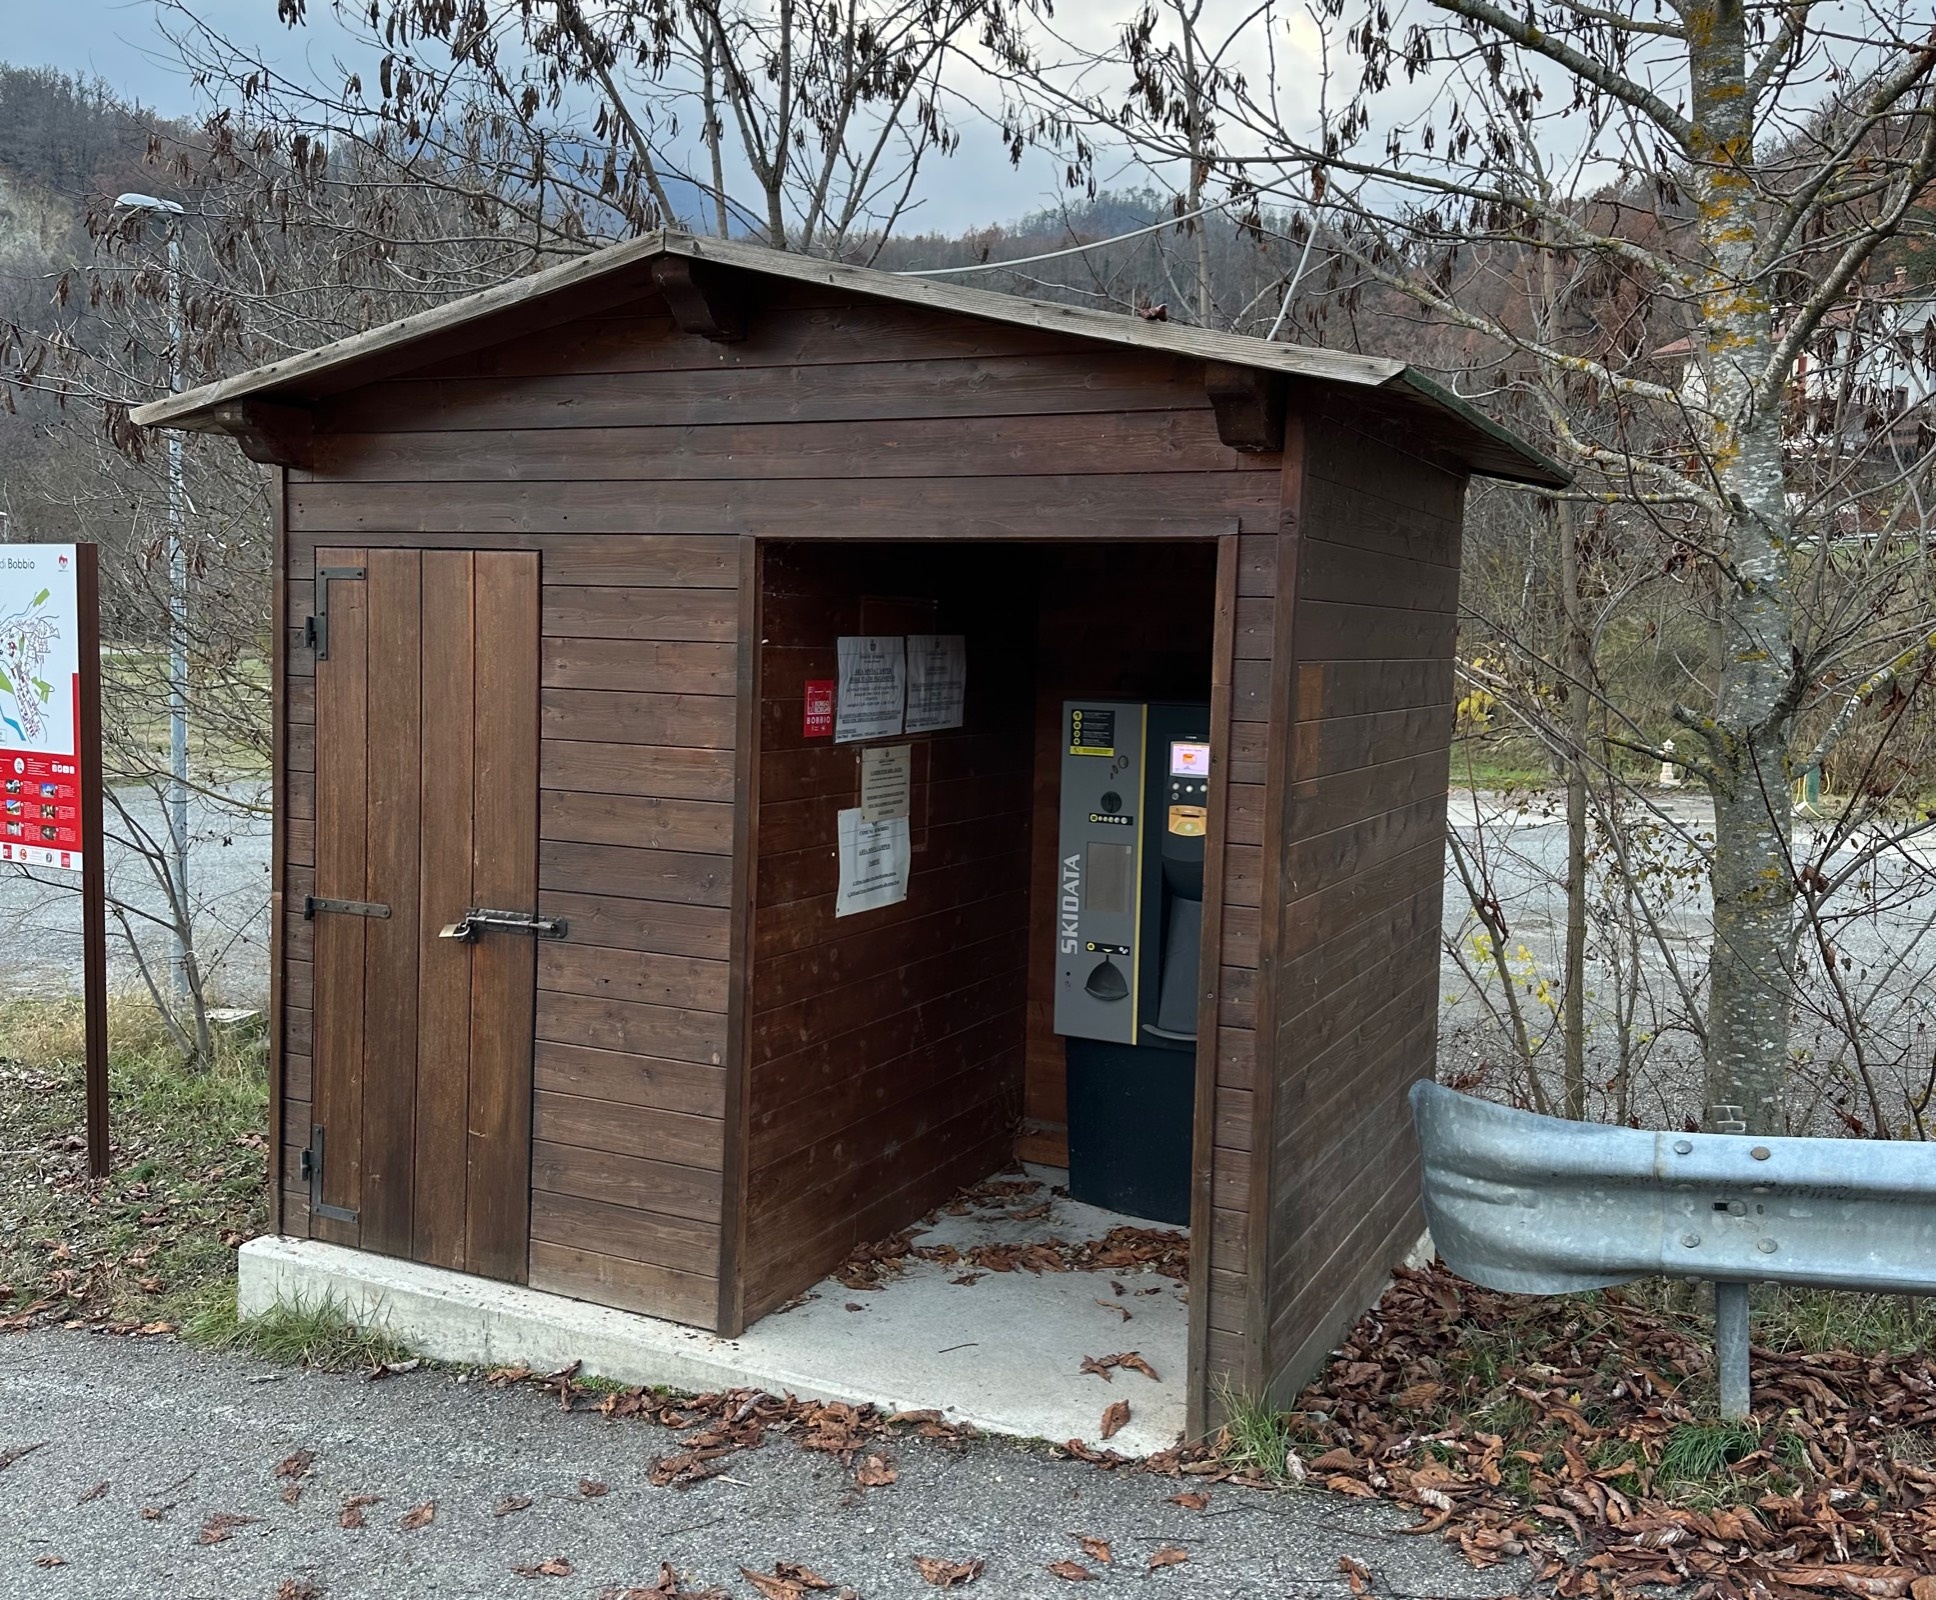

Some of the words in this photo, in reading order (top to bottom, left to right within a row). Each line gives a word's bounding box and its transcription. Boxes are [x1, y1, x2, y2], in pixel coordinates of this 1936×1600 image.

[7, 557, 35, 569] Bobbio
[806, 715, 831, 725] BOBBIO
[1061, 853, 1081, 955] SKIDATA
